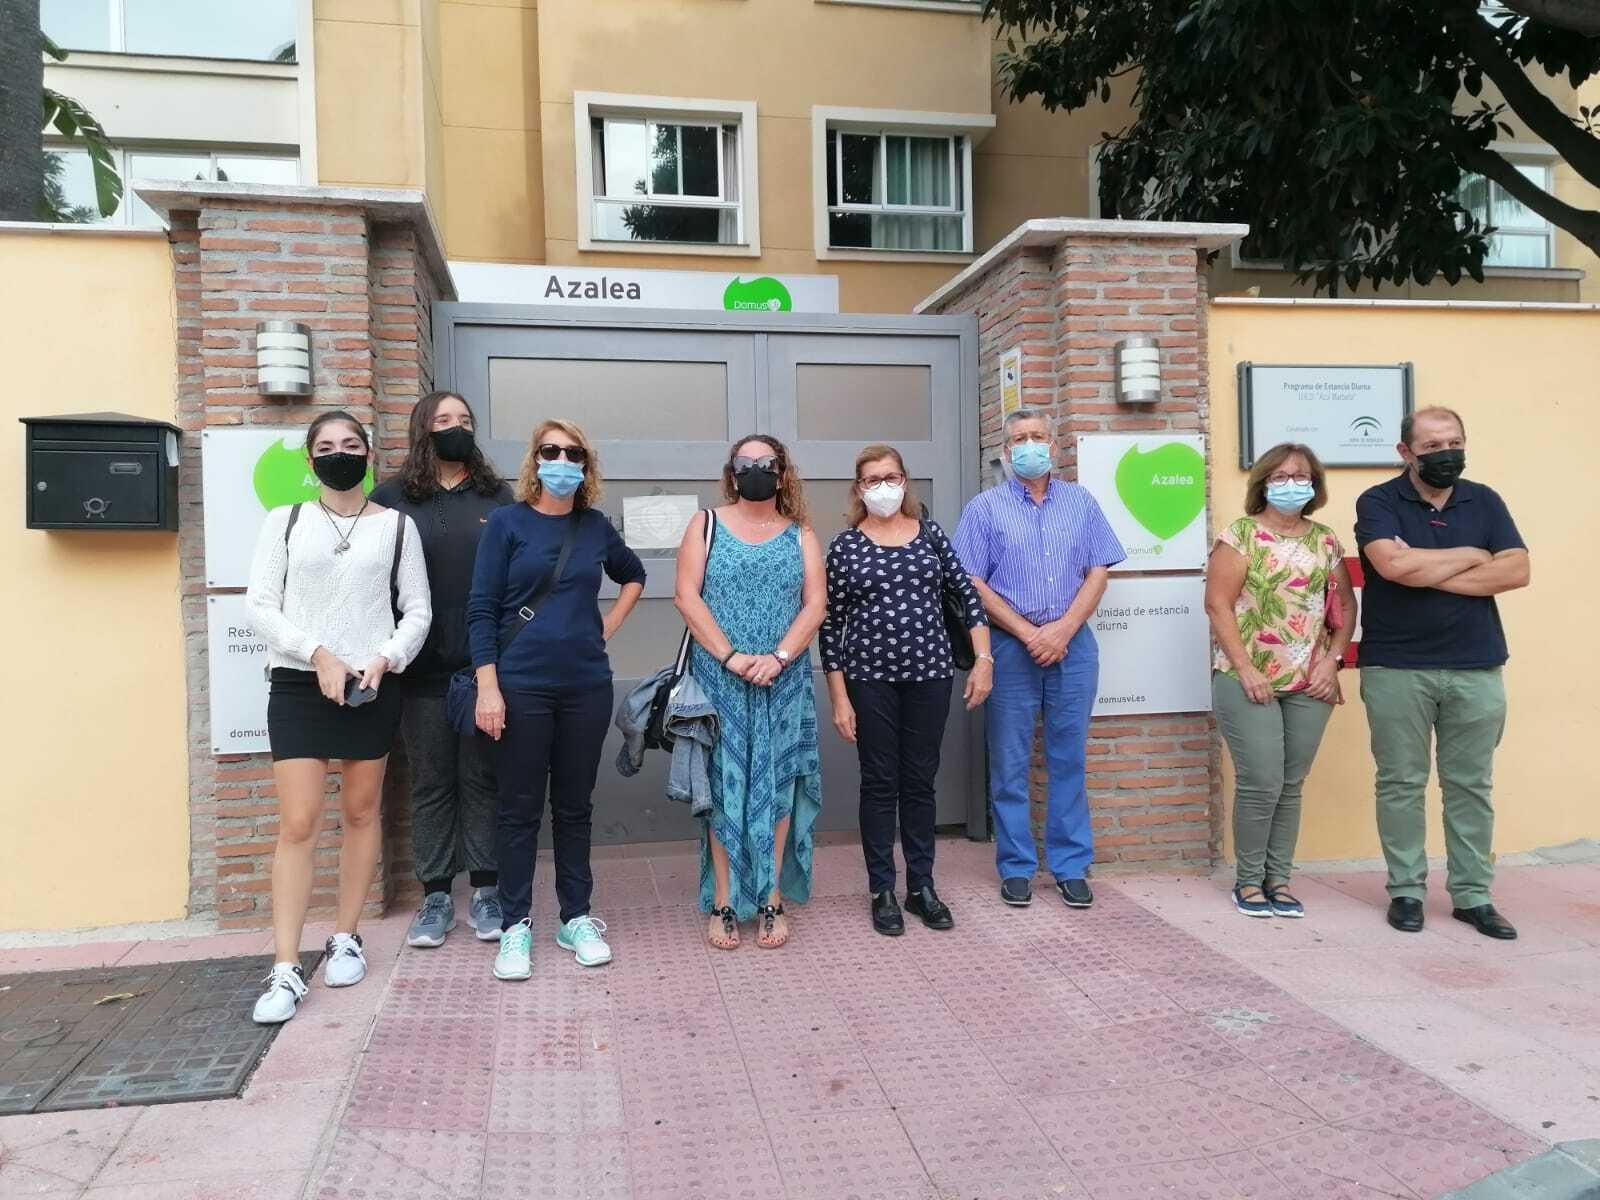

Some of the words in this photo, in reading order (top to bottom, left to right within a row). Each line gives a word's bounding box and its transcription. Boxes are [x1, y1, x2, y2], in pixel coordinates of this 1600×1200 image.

[544, 274, 641, 300] Azalea
[1315, 382, 1323, 390] de
[1151, 473, 1194, 486] Azalea
[1096, 607, 1131, 618] Unidad
[1133, 606, 1146, 616] de
[1148, 604, 1190, 616] estancia
[1096, 621, 1128, 631] diurna
